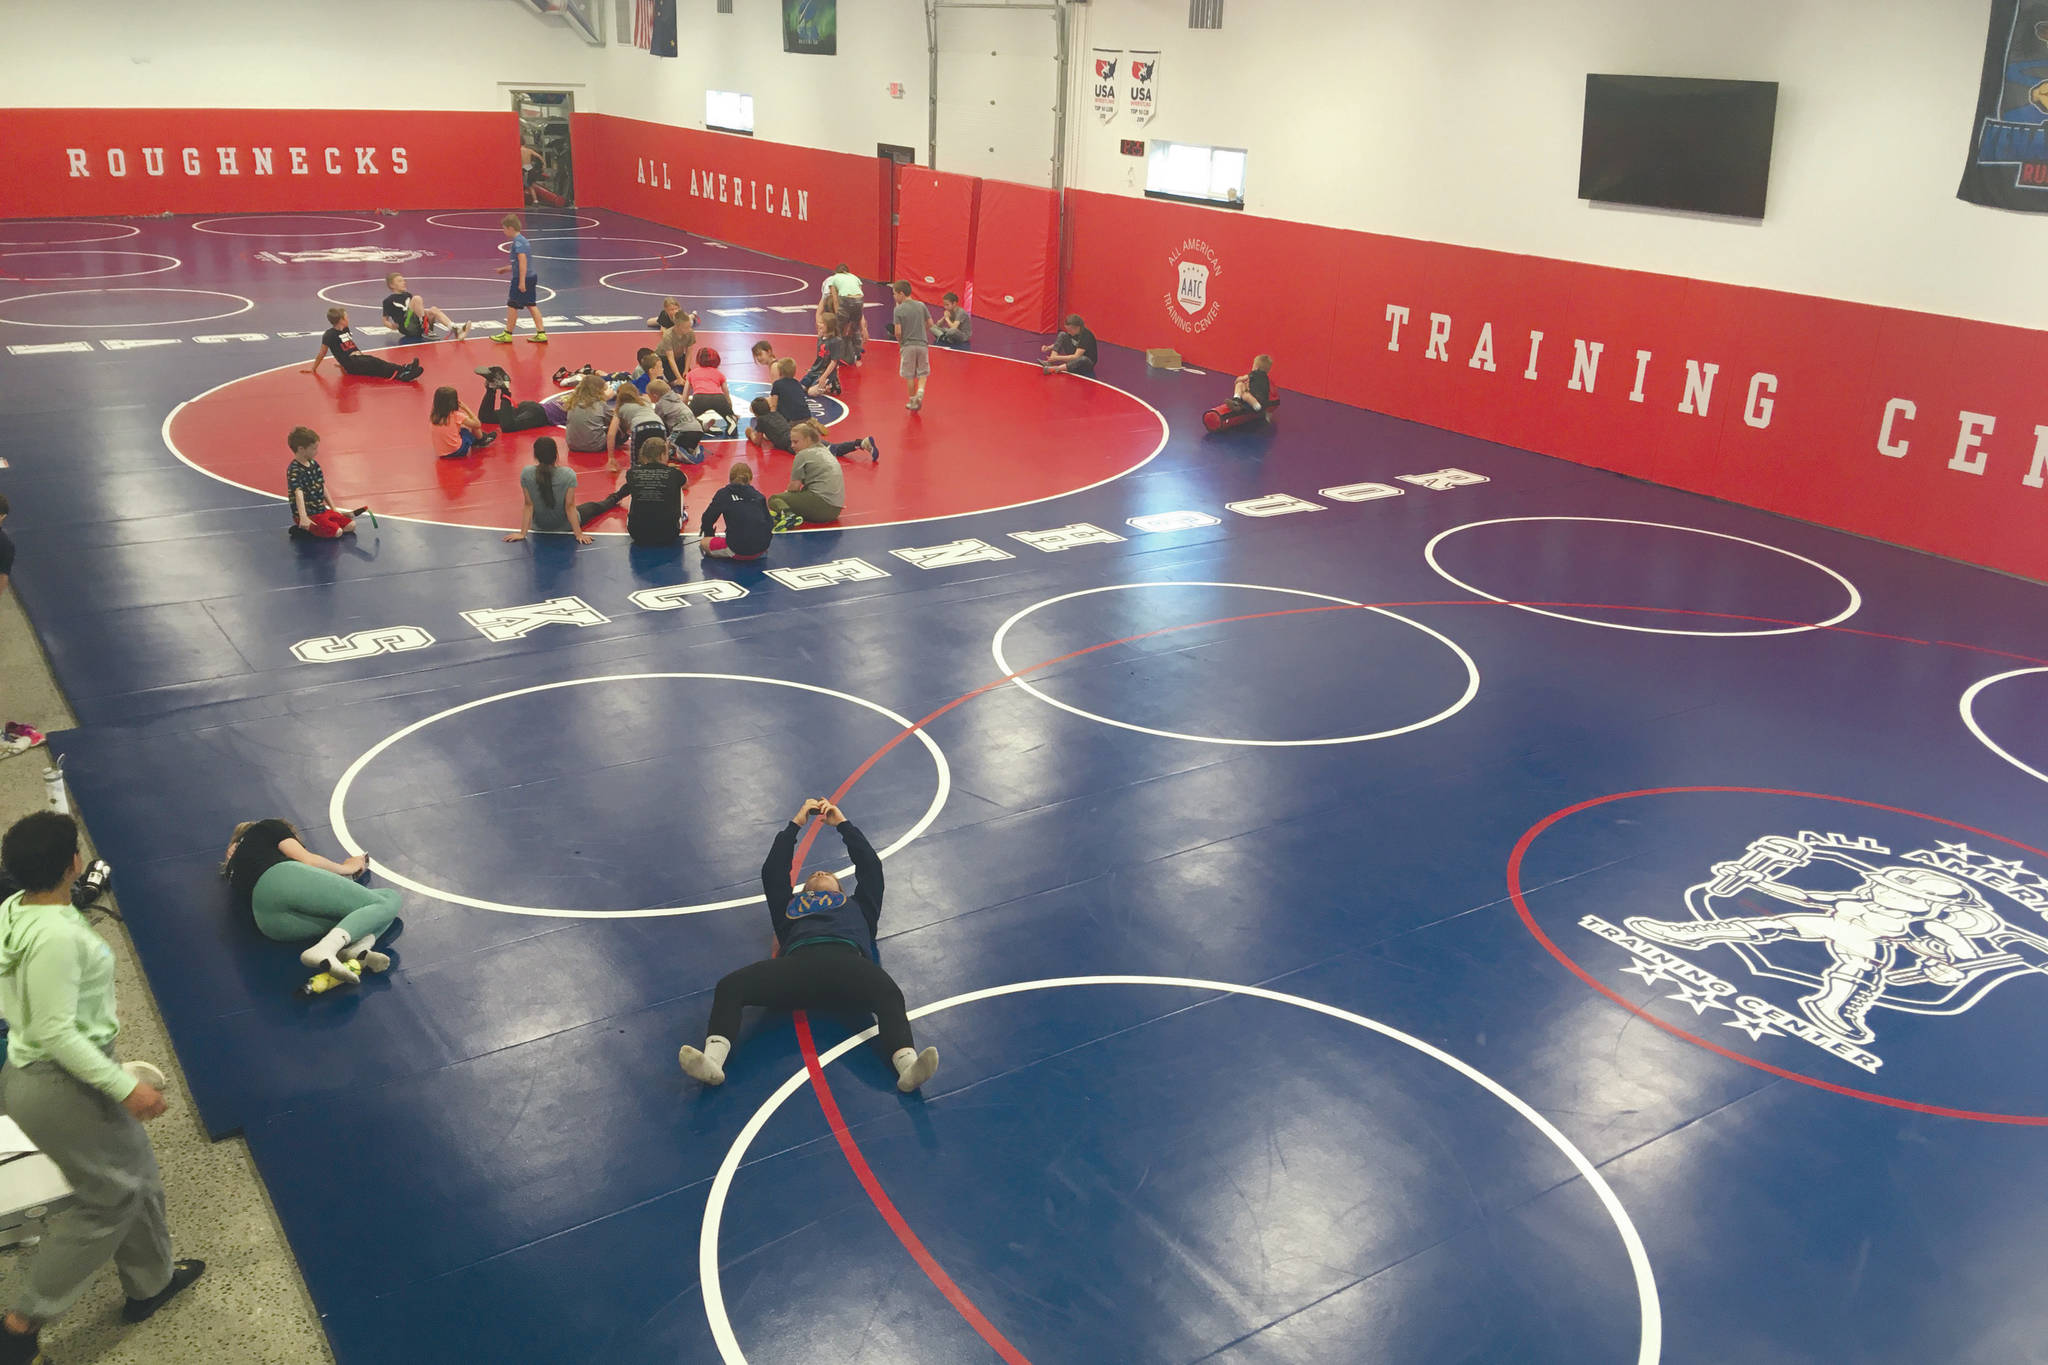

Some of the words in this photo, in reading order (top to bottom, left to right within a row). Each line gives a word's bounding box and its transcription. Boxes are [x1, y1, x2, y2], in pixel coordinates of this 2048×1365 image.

[1095, 84, 1115, 98] USA
[1131, 87, 1152, 101] USA
[66, 147, 409, 177] ROUGHNECKS
[2022, 163, 2048, 183] RU
[637, 157, 671, 190] ALL
[689, 168, 809, 222] AMERICAN
[1168, 247, 1182, 267] ALL
[1183, 238, 1223, 277] AMERICAN
[1181, 278, 1202, 299] AATC
[1163, 292, 1192, 333] TRAINING
[1193, 301, 1221, 333] CENTER
[1386, 303, 1779, 430] TRAINING
[1877, 397, 2048, 489] CEN
[288, 467, 1491, 664] ROUGHNECKS
[1798, 830, 1891, 856] ALL
[1577, 914, 1738, 997] TRAINING
[1735, 995, 1884, 1074] CENTER
